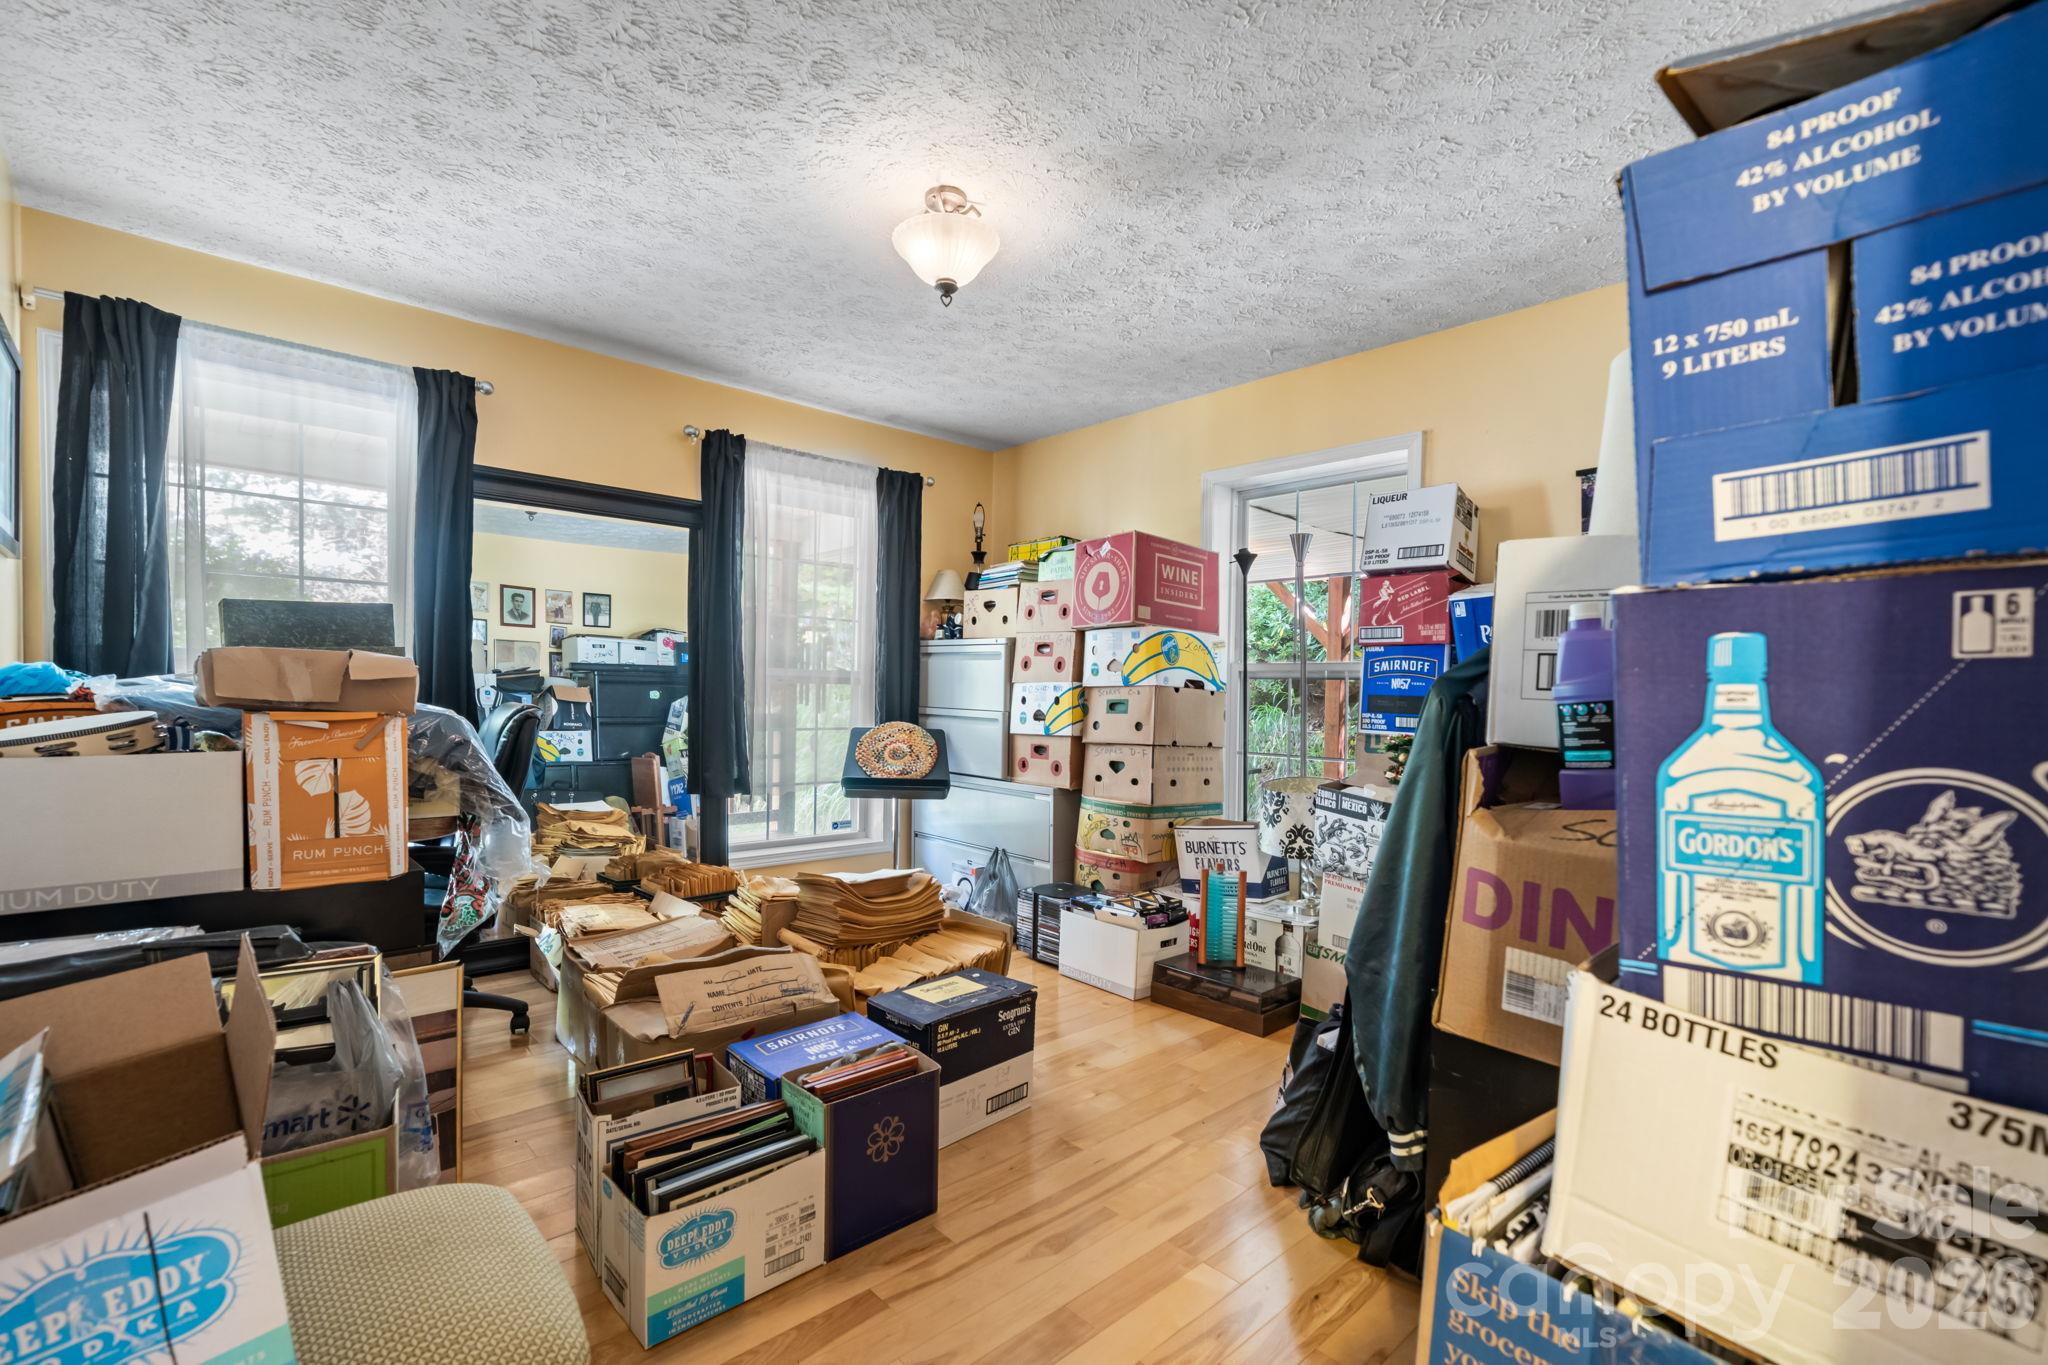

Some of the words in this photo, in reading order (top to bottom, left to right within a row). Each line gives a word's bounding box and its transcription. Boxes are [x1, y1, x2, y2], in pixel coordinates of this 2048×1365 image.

[1766, 125, 1796, 150] 84
[1800, 87, 1902, 141] PROOF
[1735, 159, 1788, 189] 42%
[1792, 108, 1941, 173] ALCOHOL
[1751, 188, 1789, 214] BY
[1794, 144, 1922, 199] VOLUME
[1910, 259, 1942, 285] 84
[1874, 293, 1932, 326] 42%
[1652, 335, 1678, 357] 12
[1684, 331, 1699, 349] x
[1703, 316, 1748, 345] 750
[1754, 307, 1799, 332] mL
[1893, 326, 1933, 354] BY
[1661, 360, 1677, 380] 9
[1683, 337, 1787, 376] LITERS
[1372, 493, 1408, 504] LIQUEUR
[1161, 563, 1199, 586] WINE
[1160, 586, 1199, 600] INSIDERS
[1397, 593, 1410, 602] RED
[1409, 585, 1430, 598] LABEL
[2006, 593, 2021, 615] 6
[1374, 660, 1430, 673] SMIRNOFF
[263, 806, 274, 827] RUM
[293, 849, 326, 861] RUM
[333, 845, 384, 858] PUNCH
[1185, 840, 1247, 855] BURNETT'S
[74, 878, 160, 904] DUTY
[1324, 878, 1353, 892] PREMIUM
[707, 989, 726, 999] NAME
[711, 1001, 743, 1013] CONTENTS
[998, 1004, 1031, 1023] Seagram's
[766, 1023, 847, 1050] SMIRNOFF
[938, 1022, 949, 1033] GIN
[1007, 1026, 1021, 1037] GIN
[1599, 994, 1634, 1023] 24
[1640, 1001, 1781, 1071] BOTTLES
[807, 1044, 858, 1061] VODKA
[667, 1231, 694, 1252] DEEP
[702, 1217, 728, 1236] EDDY
[672, 1235, 724, 1259] VODKA
[103, 1252, 204, 1320] EDDY
[672, 1300, 721, 1327] HANDCRAFTED
[1452, 1267, 1518, 1323] Skip
[1528, 1307, 1581, 1353] the
